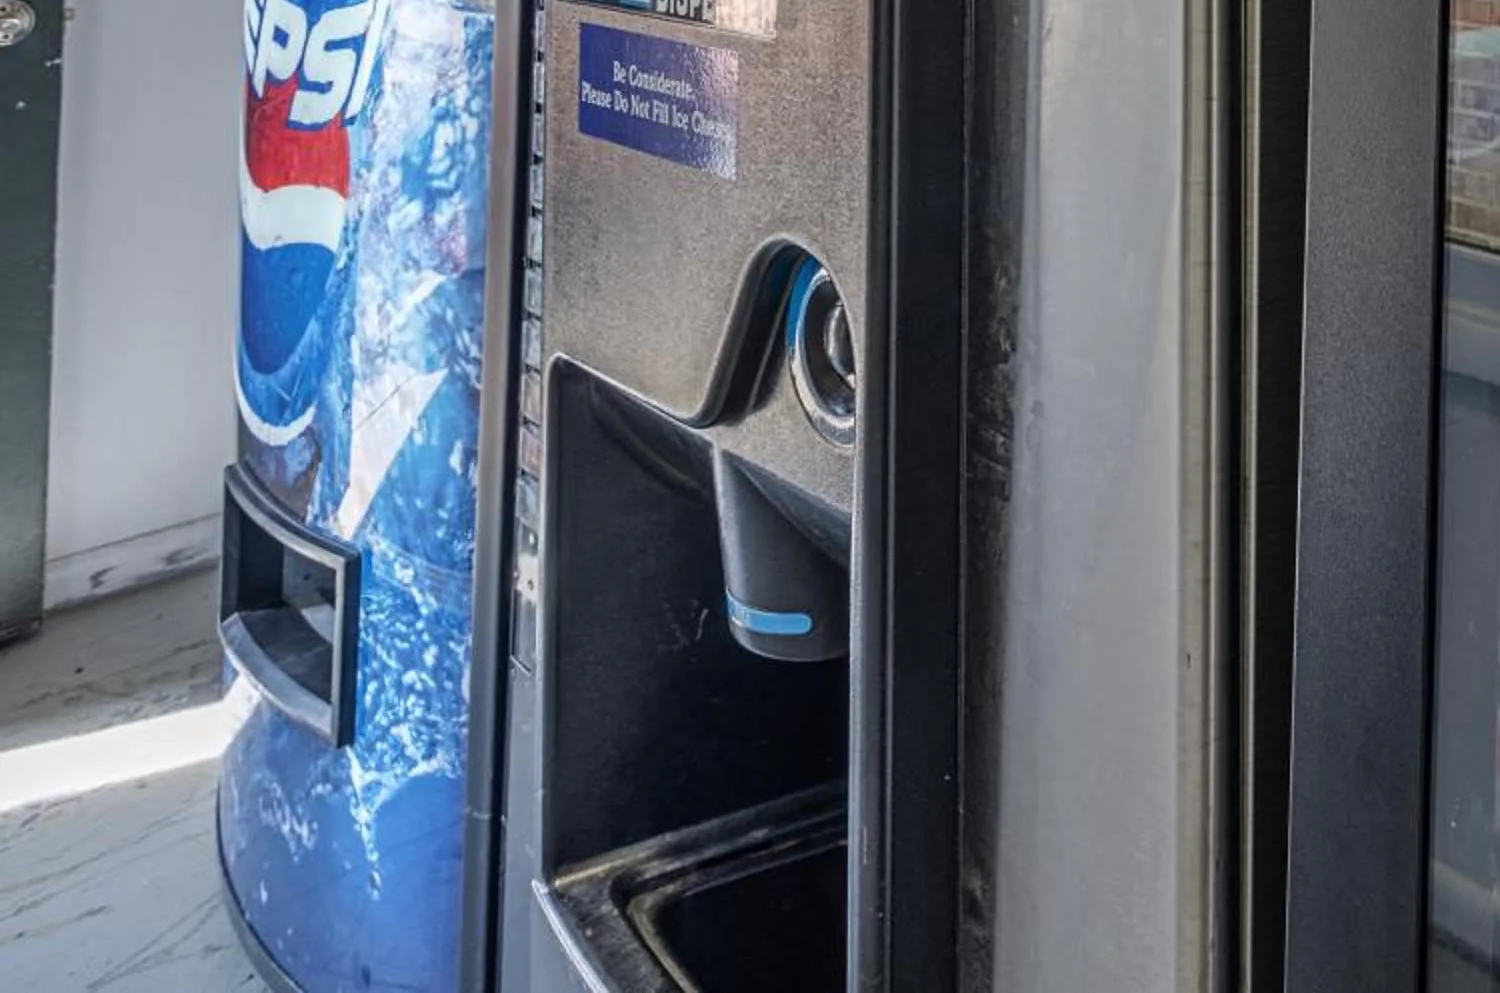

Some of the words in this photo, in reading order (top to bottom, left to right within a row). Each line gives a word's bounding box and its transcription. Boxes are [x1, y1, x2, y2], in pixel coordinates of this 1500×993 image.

[613, 60, 627, 85] Be
[580, 80, 613, 109] Please
[613, 89, 629, 114] Do
[630, 94, 651, 120] Not
[651, 99, 670, 128] Fill
